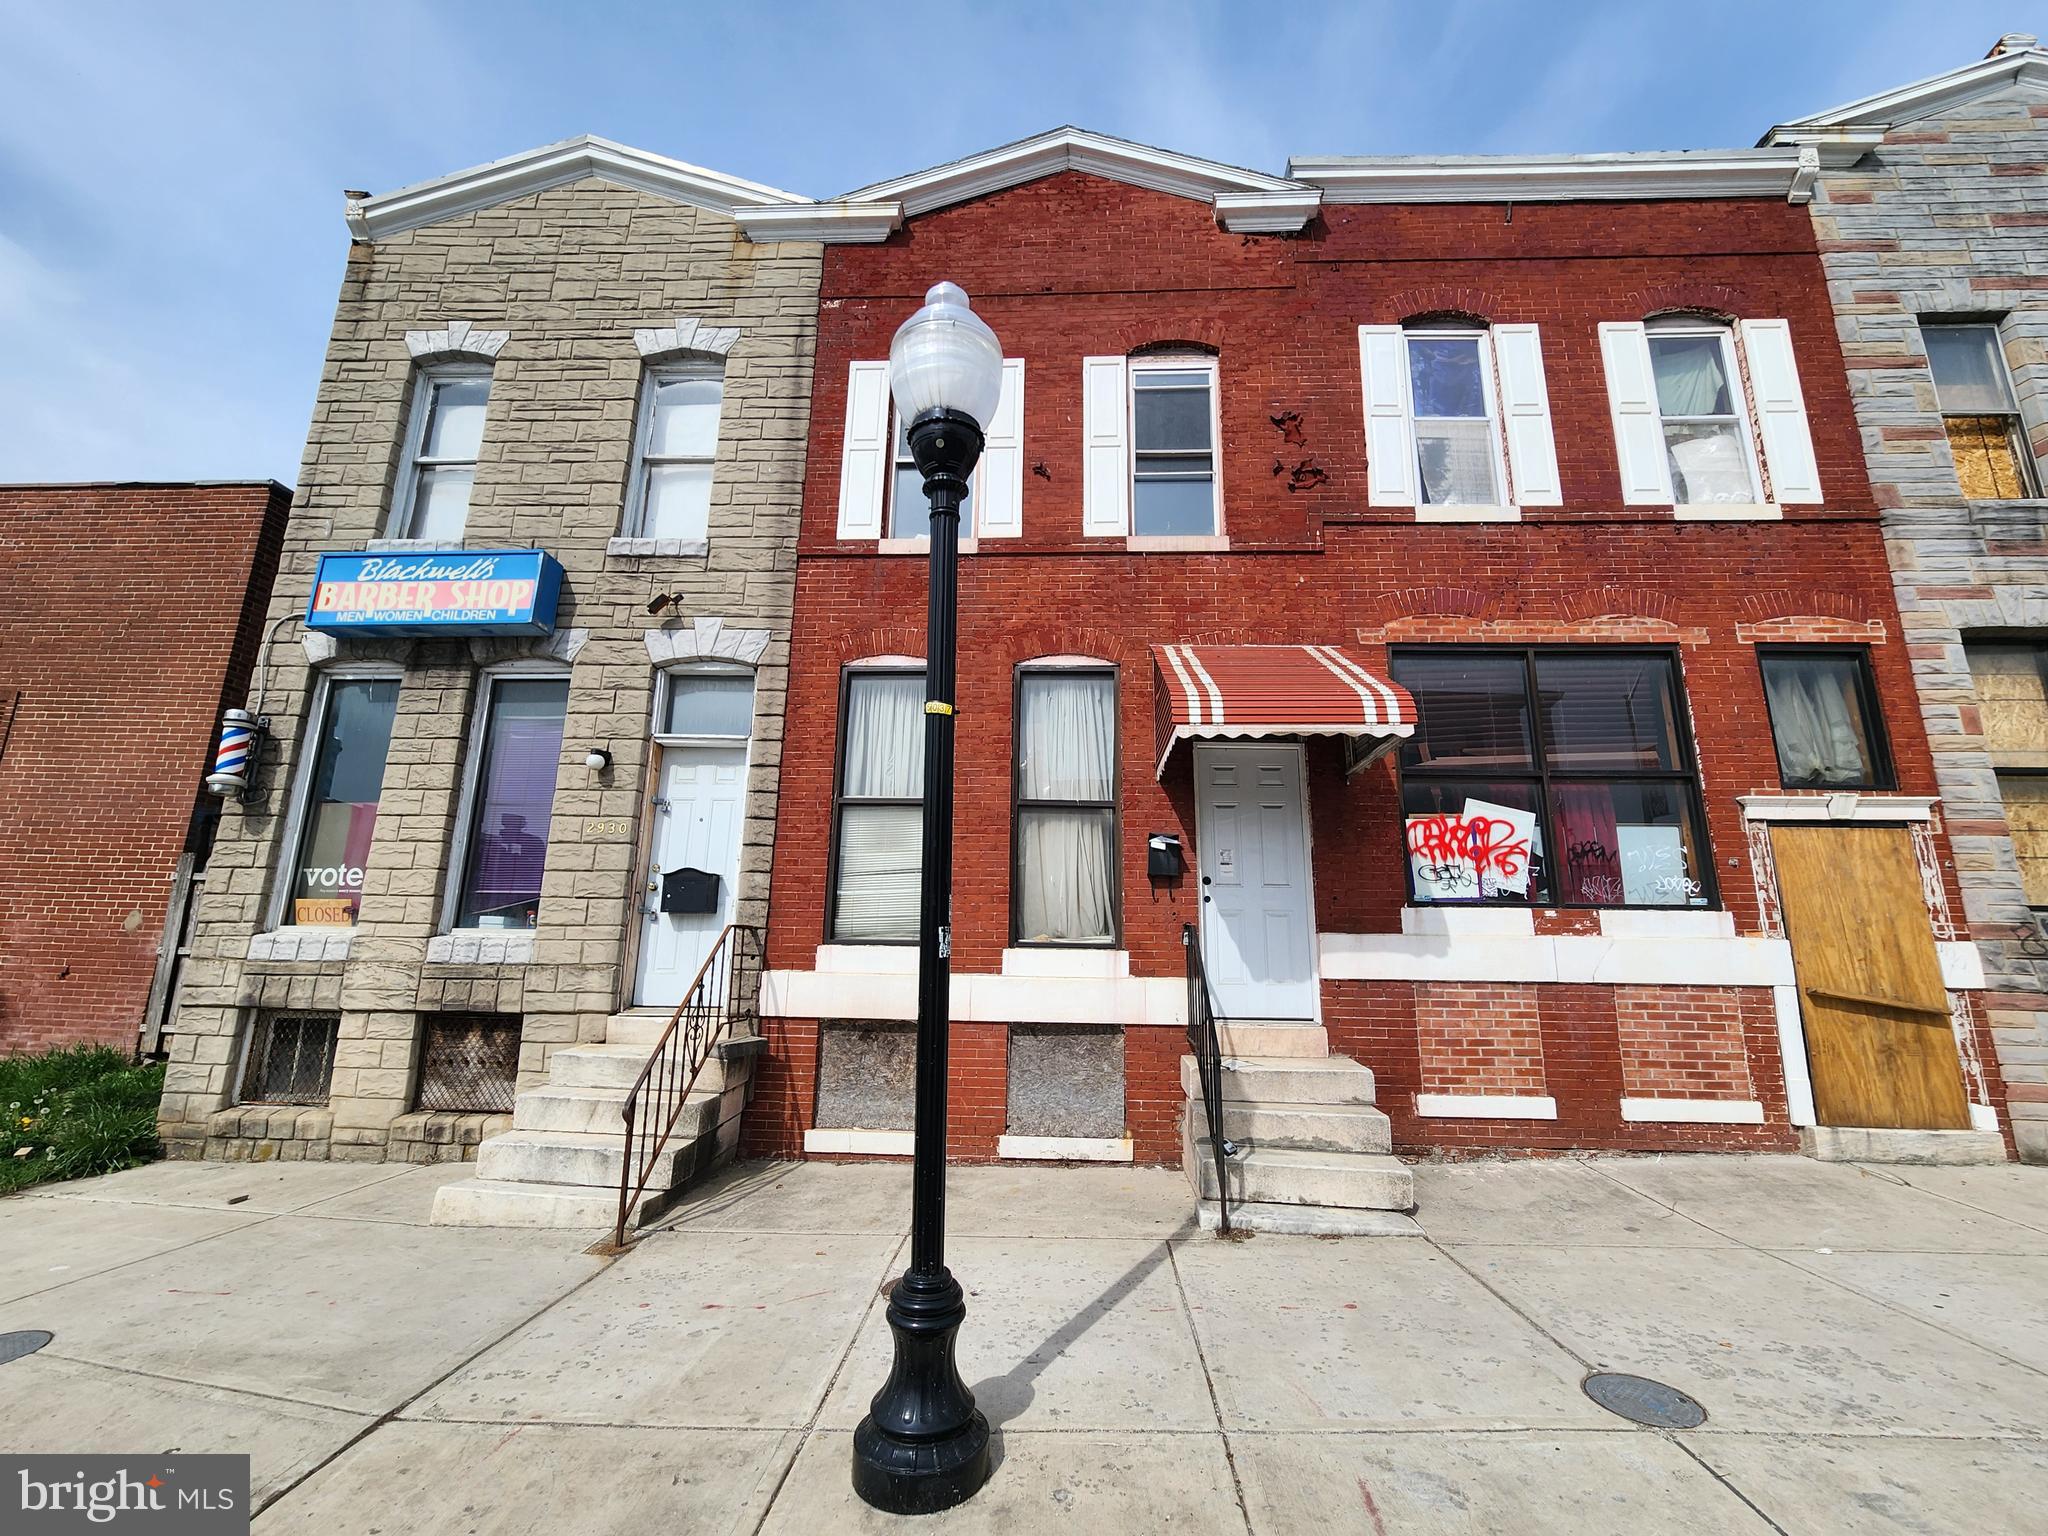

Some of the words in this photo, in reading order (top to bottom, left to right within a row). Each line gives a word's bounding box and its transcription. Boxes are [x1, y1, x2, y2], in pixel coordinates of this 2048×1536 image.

[357, 558, 499, 581] Blackwell's
[317, 582, 437, 617] BARBER
[450, 580, 531, 616] SHOP
[336, 611, 365, 622] MEN
[374, 611, 423, 621] WOMEN
[431, 610, 496, 621] CHILDREN
[586, 822, 627, 834] 2930
[304, 863, 363, 887] vote
